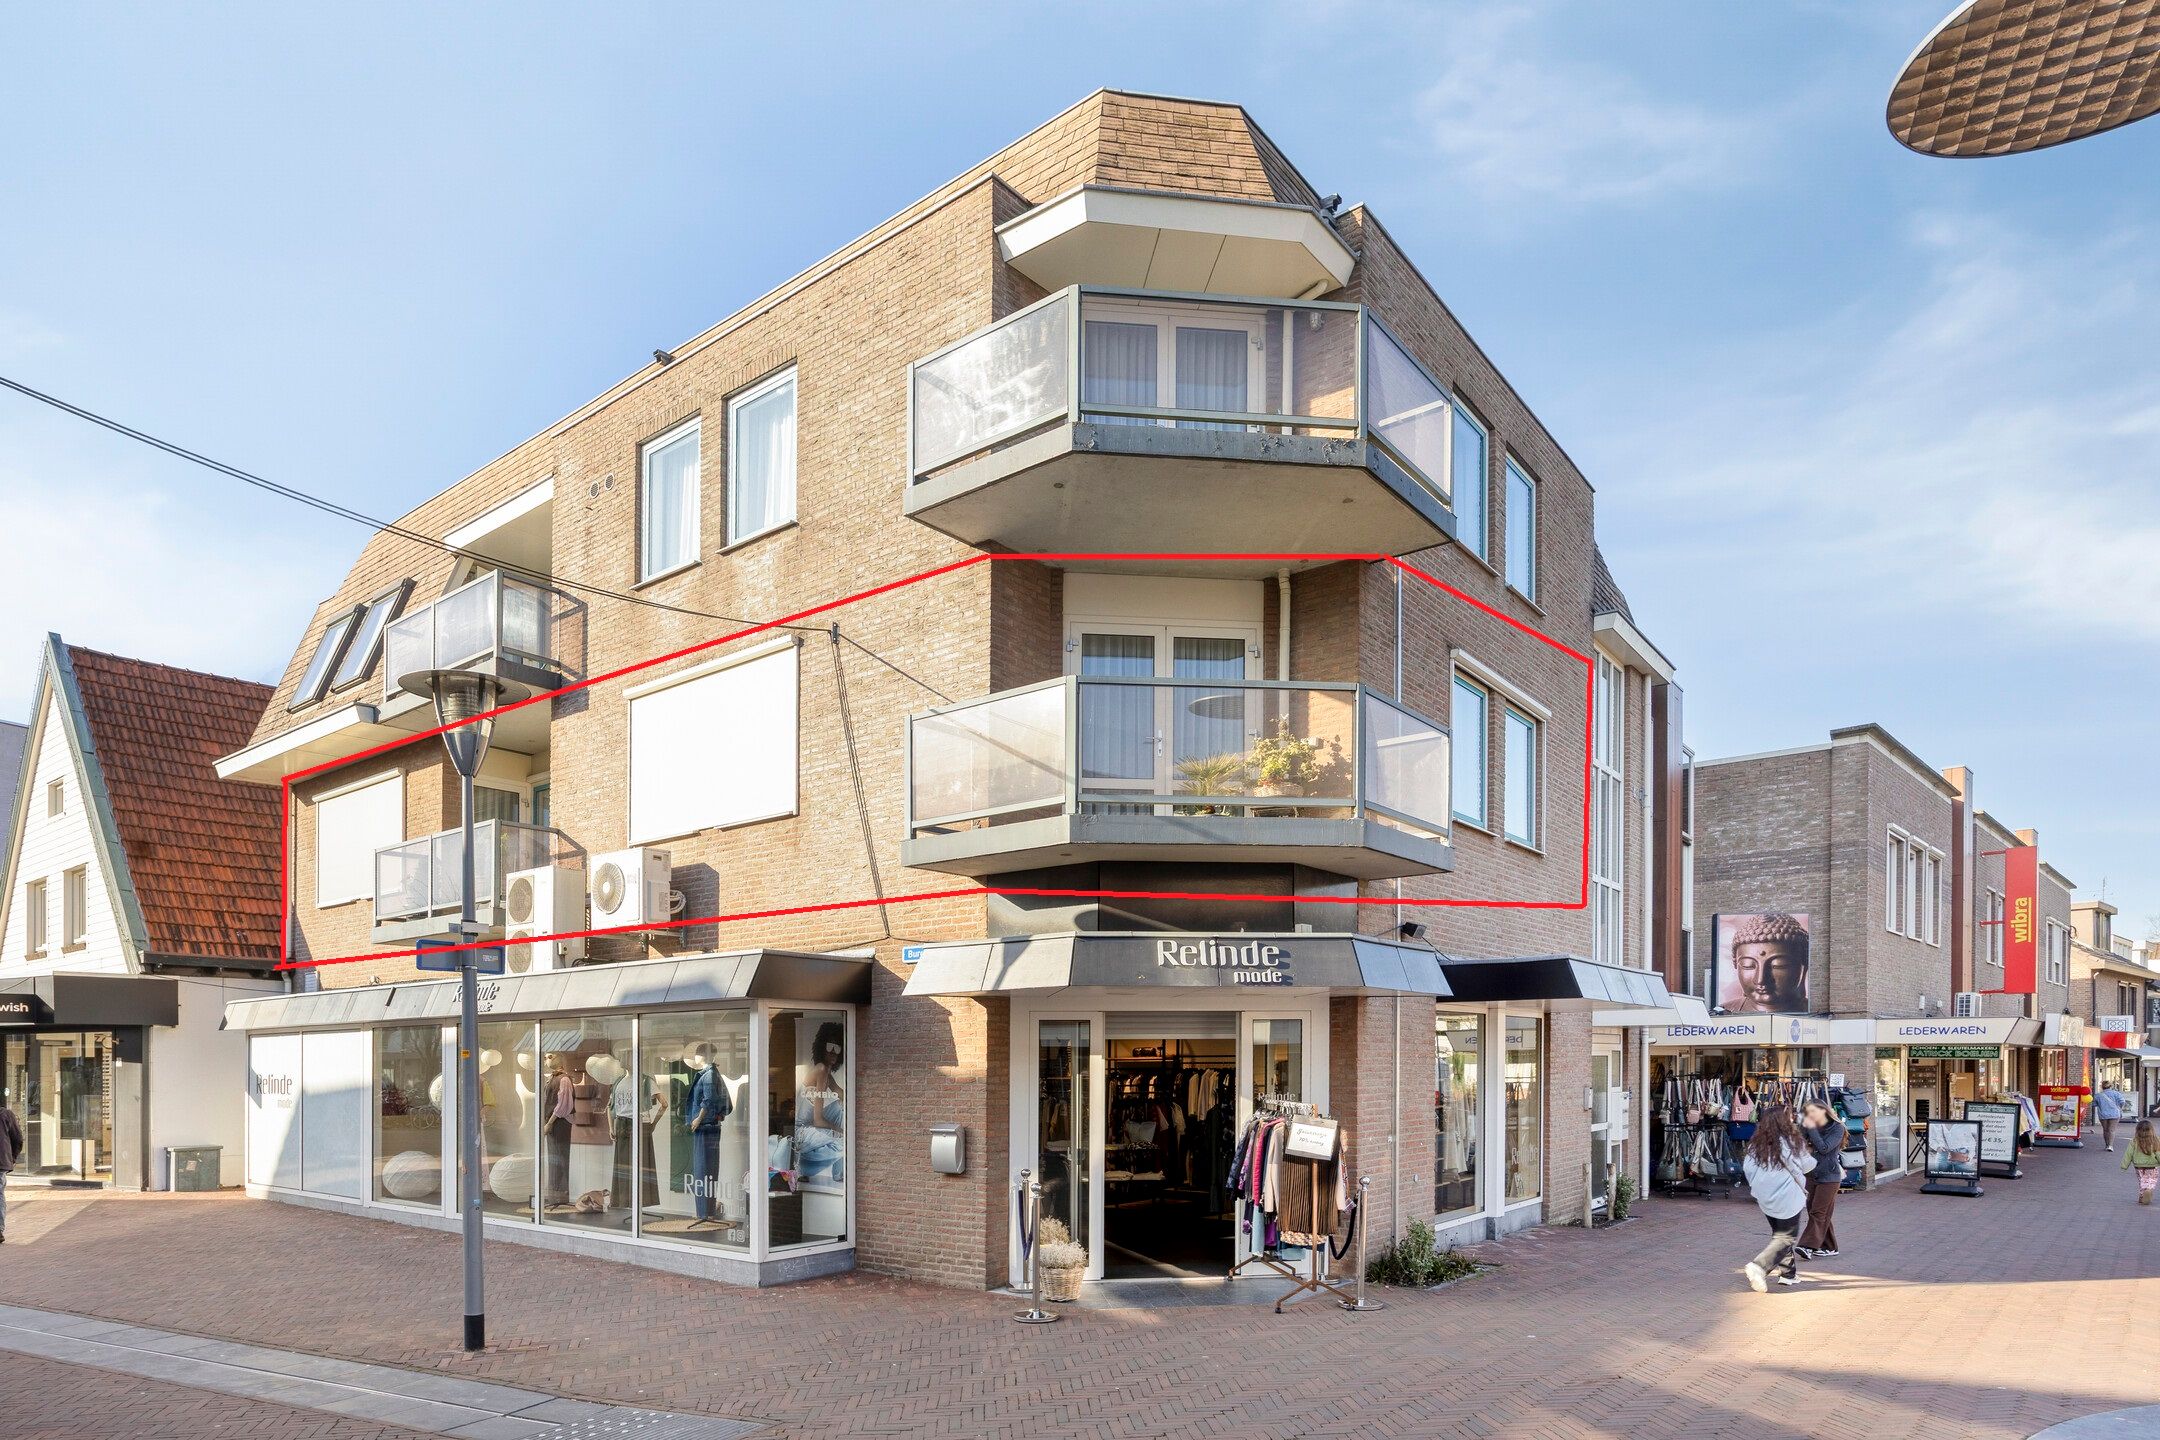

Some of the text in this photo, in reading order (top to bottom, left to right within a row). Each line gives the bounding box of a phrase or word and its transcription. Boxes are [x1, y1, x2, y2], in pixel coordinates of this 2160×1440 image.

[2010, 896, 2029, 944] wibra
[1157, 939, 1280, 967] Relinde
[1233, 968, 1283, 984] mode
[452, 981, 500, 1003] Rinde
[0, 1002, 29, 1013] wish
[1666, 1024, 1756, 1037] LEDERWAREN
[1898, 1025, 1987, 1036] LEDERWAREN
[256, 1074, 293, 1095] Relinde
[800, 1091, 839, 1099] CAMBIO
[1257, 1091, 1296, 1101] Relinde
[684, 1173, 744, 1201] Relinde
